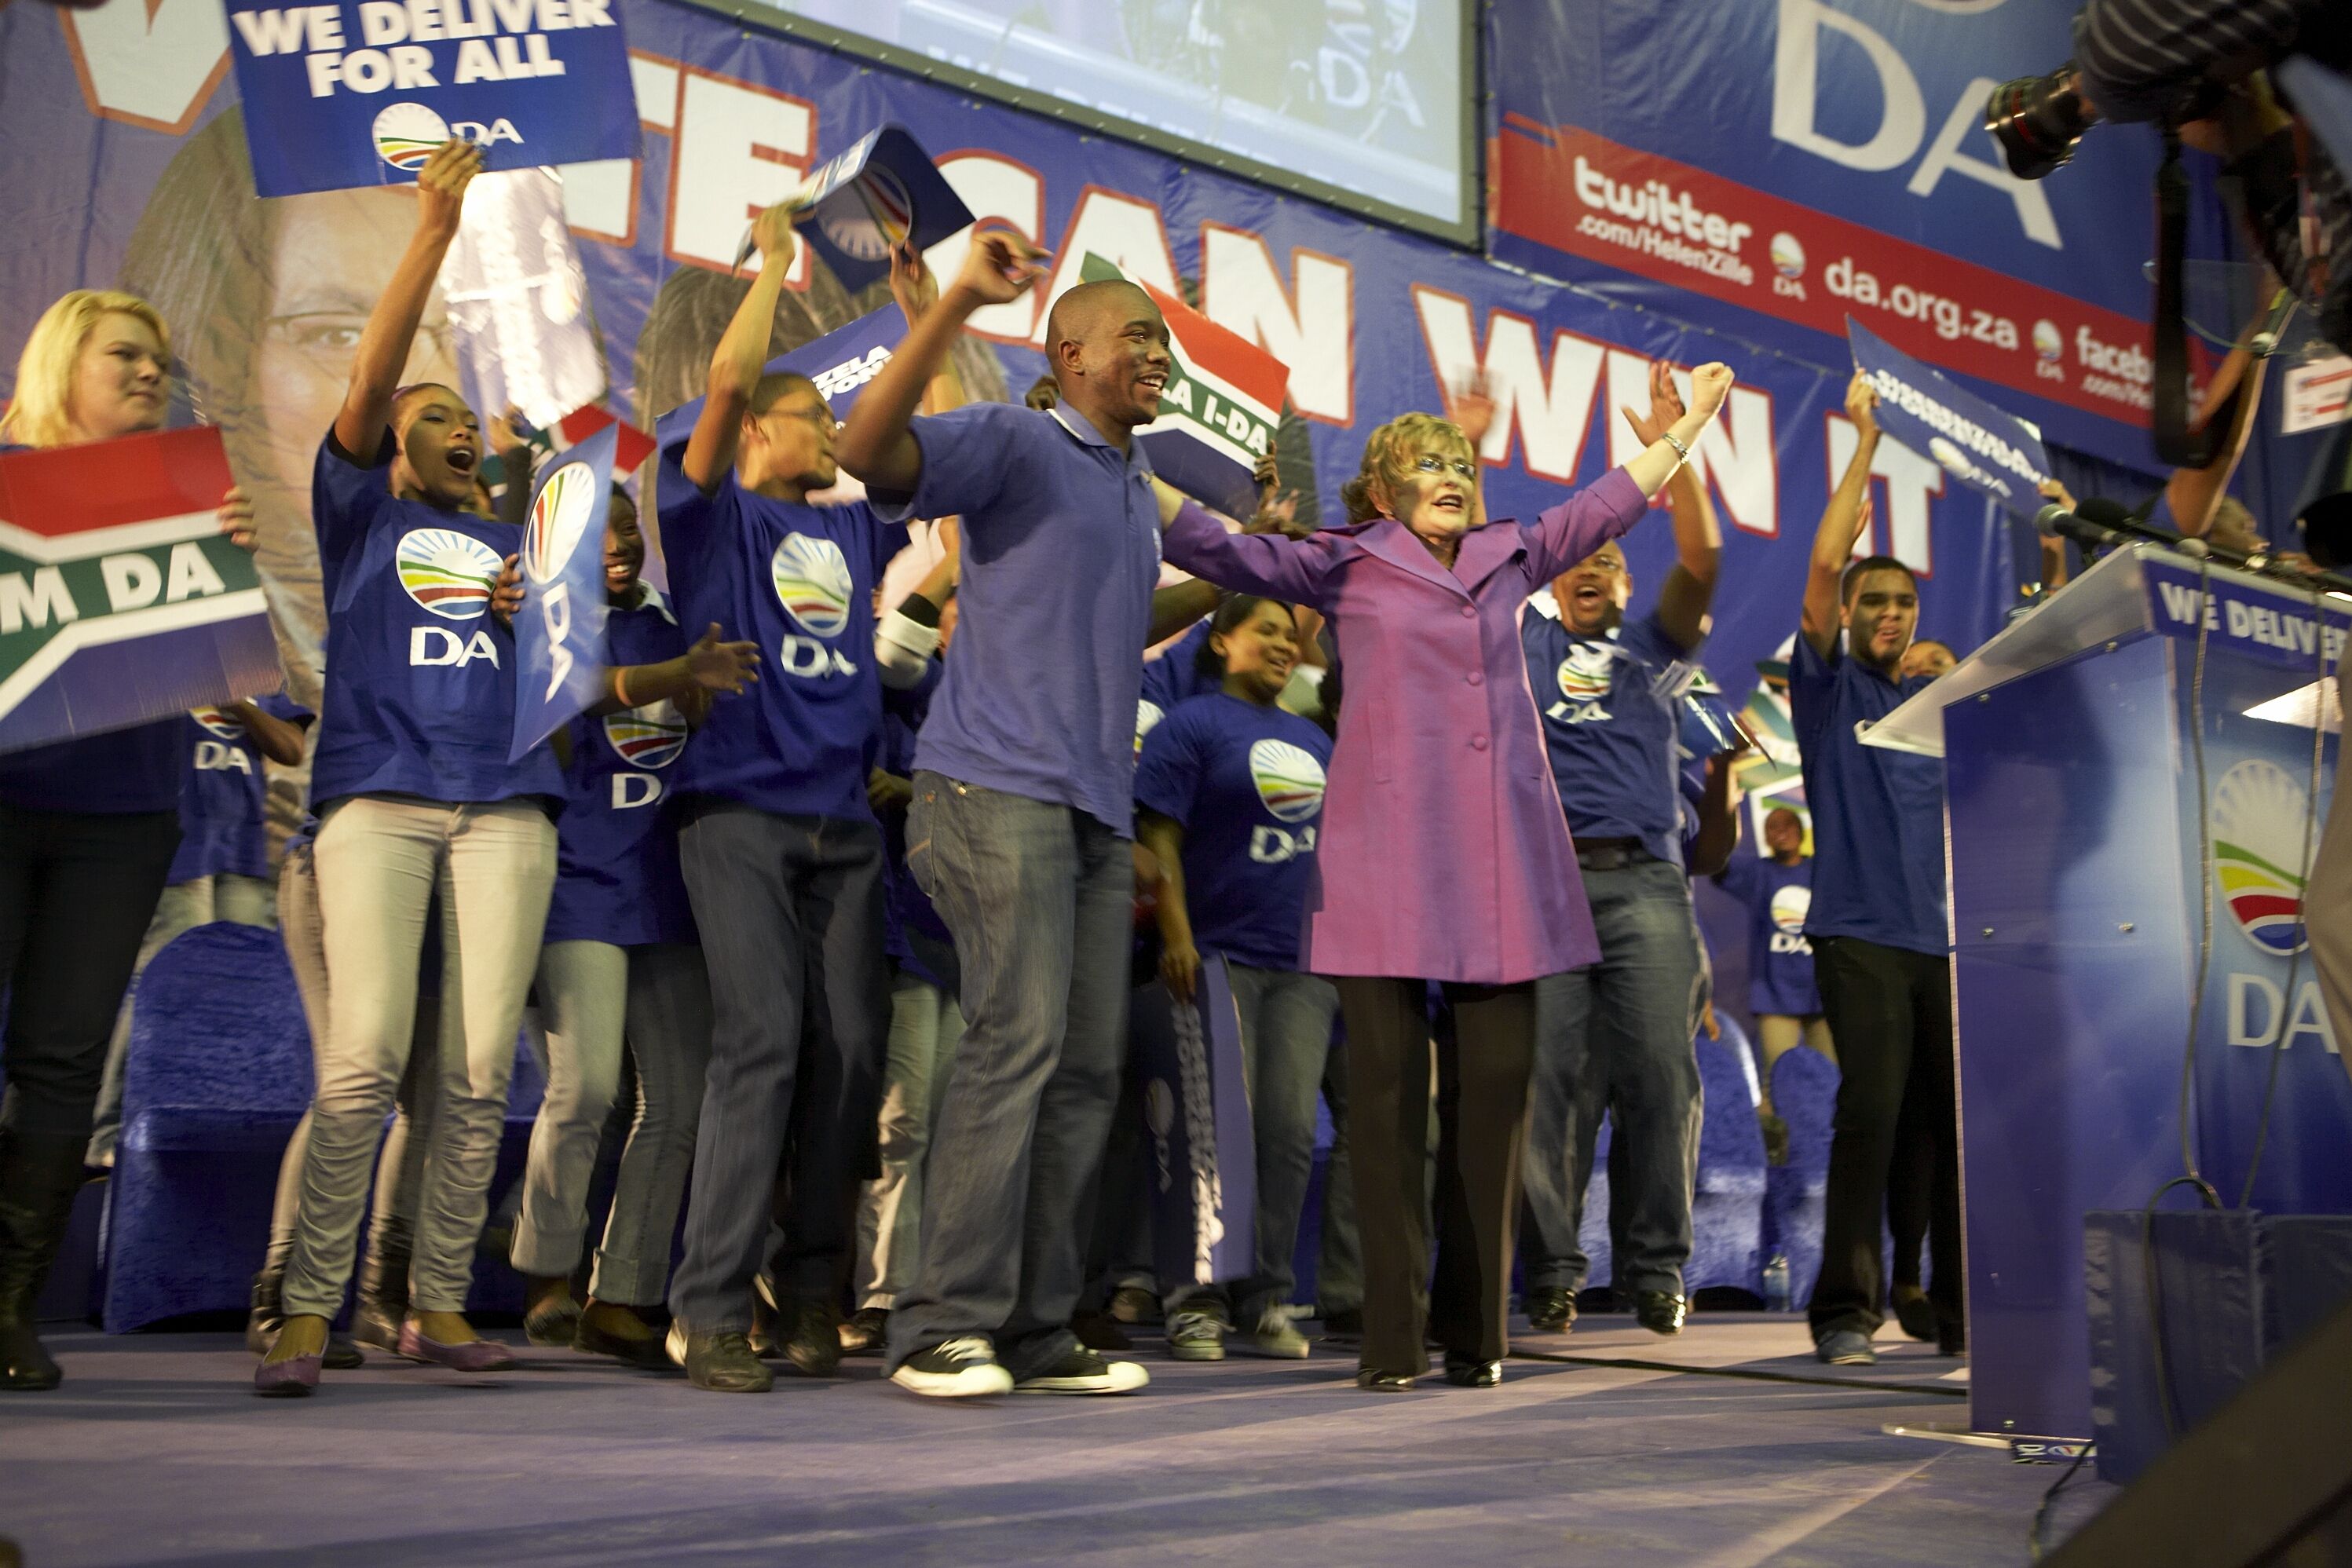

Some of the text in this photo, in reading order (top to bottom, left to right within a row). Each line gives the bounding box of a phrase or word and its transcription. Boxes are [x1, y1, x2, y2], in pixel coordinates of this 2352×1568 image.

[232, 0, 617, 57] WE DELIVER
[305, 34, 566, 97] FOR ALL
[1319, 46, 1425, 143] DA
[451, 118, 525, 146] DA
[1772, 0, 2062, 250] DA
[1575, 155, 1751, 253] twitter
[1773, 275, 1805, 300] DA
[1824, 257, 2019, 350] da.org.za
[2076, 326, 2156, 385] faceb
[1203, 393, 1267, 455] I-DA
[1825, 409, 1945, 579] IT
[101, 541, 226, 613] DA
[2158, 581, 2220, 630] WE
[410, 627, 500, 671] DA
[541, 580, 573, 704] DA
[781, 634, 858, 678] DA
[1545, 701, 1614, 724] DA
[193, 741, 252, 776] DA
[612, 773, 664, 810] D
[1249, 824, 1316, 863] DA
[1770, 932, 1813, 956] DA
[2227, 972, 2341, 1054] DA
